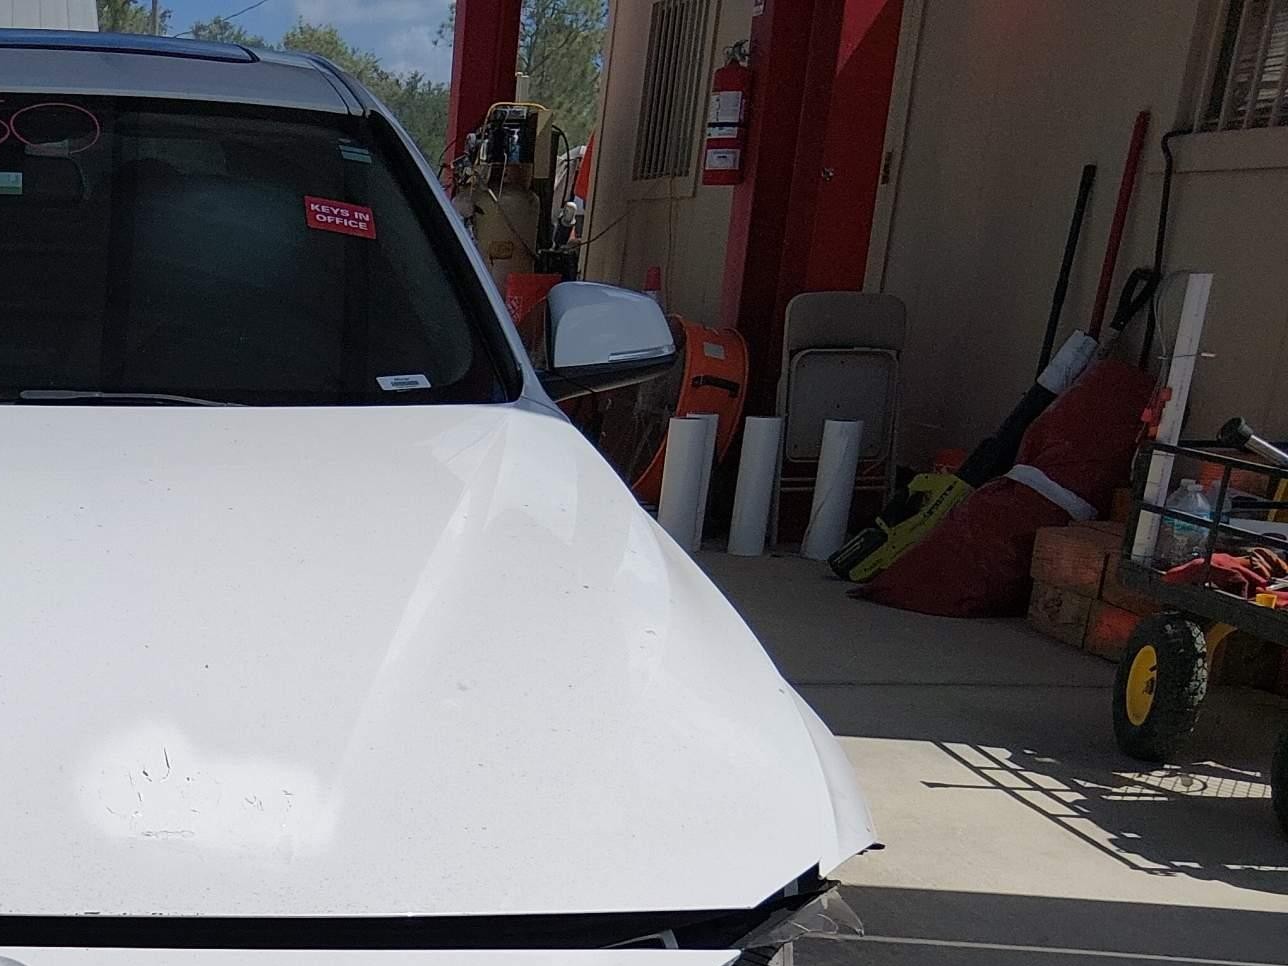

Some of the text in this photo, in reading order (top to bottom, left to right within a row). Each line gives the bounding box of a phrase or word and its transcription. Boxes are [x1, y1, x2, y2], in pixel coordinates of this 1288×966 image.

[310, 203, 370, 221] KEYS IN
[315, 213, 369, 230] OFFICE
